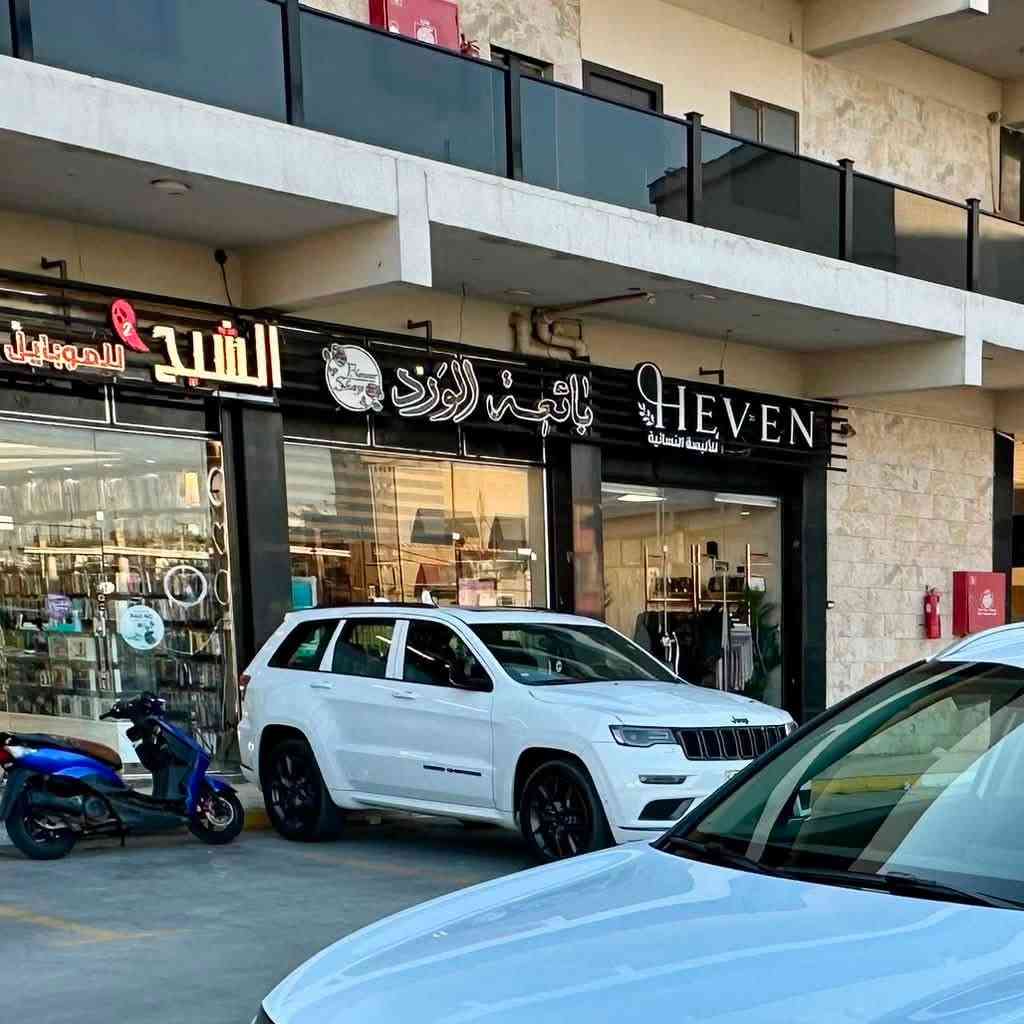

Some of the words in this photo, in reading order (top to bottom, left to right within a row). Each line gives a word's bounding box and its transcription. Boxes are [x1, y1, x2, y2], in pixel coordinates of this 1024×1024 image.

[391, 354, 480, 423] الورد
[486, 370, 593, 436] بائعة
[637, 362, 815, 449] HEVEN
